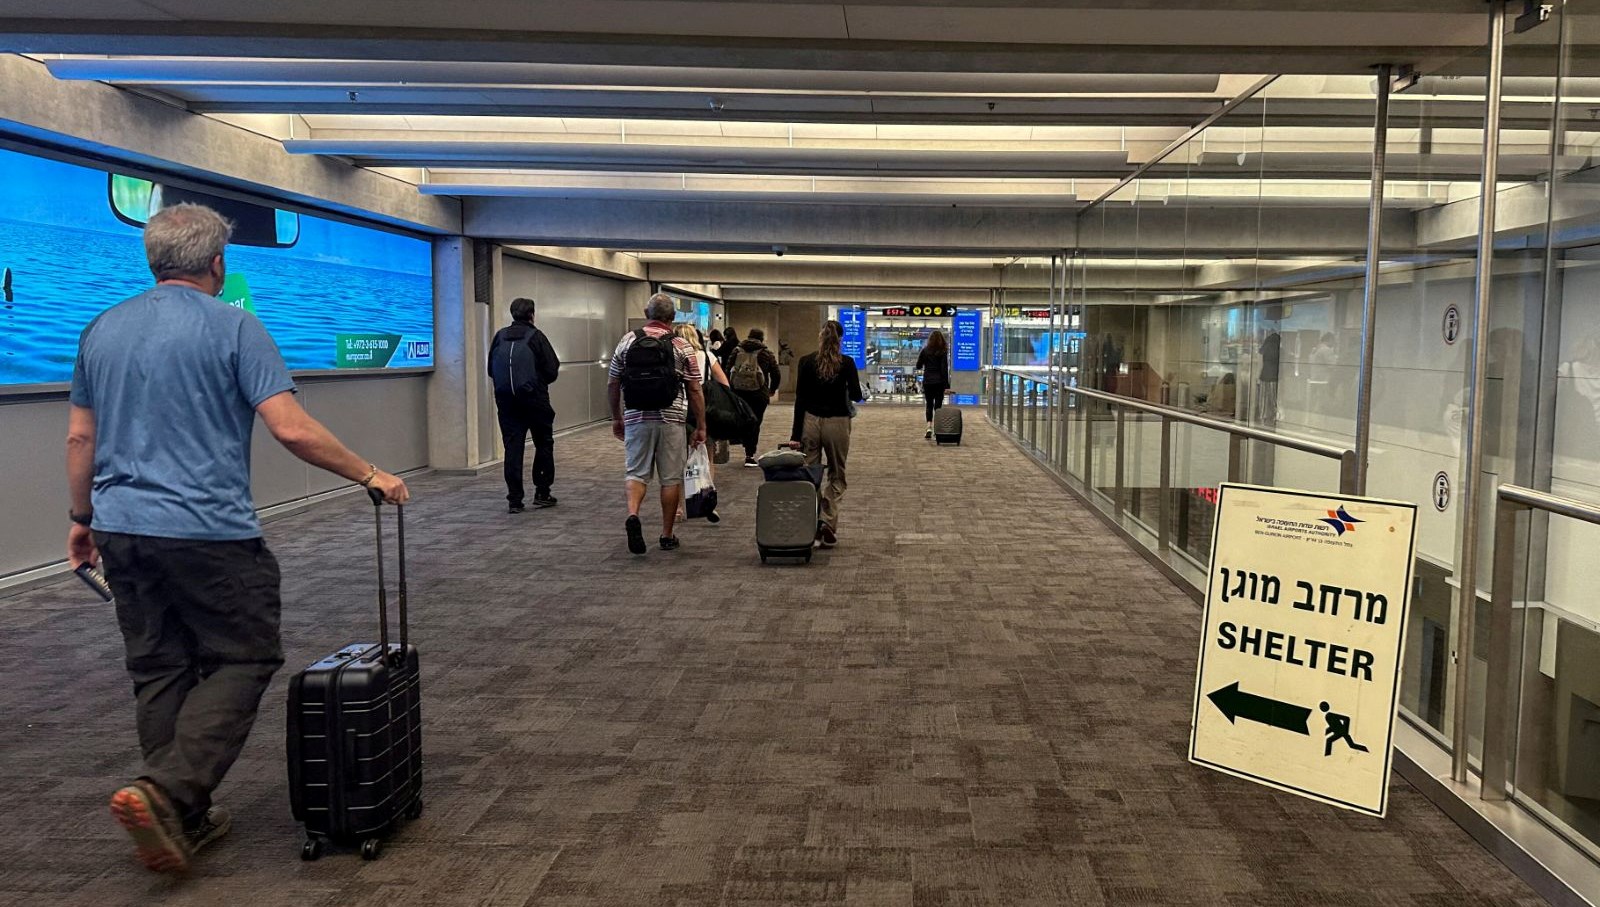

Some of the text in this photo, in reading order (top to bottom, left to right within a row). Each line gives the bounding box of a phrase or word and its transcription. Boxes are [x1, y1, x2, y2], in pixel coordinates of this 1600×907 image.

[1220, 567, 1388, 624] מרחב מוגן
[1217, 622, 1375, 681] SHELTER
